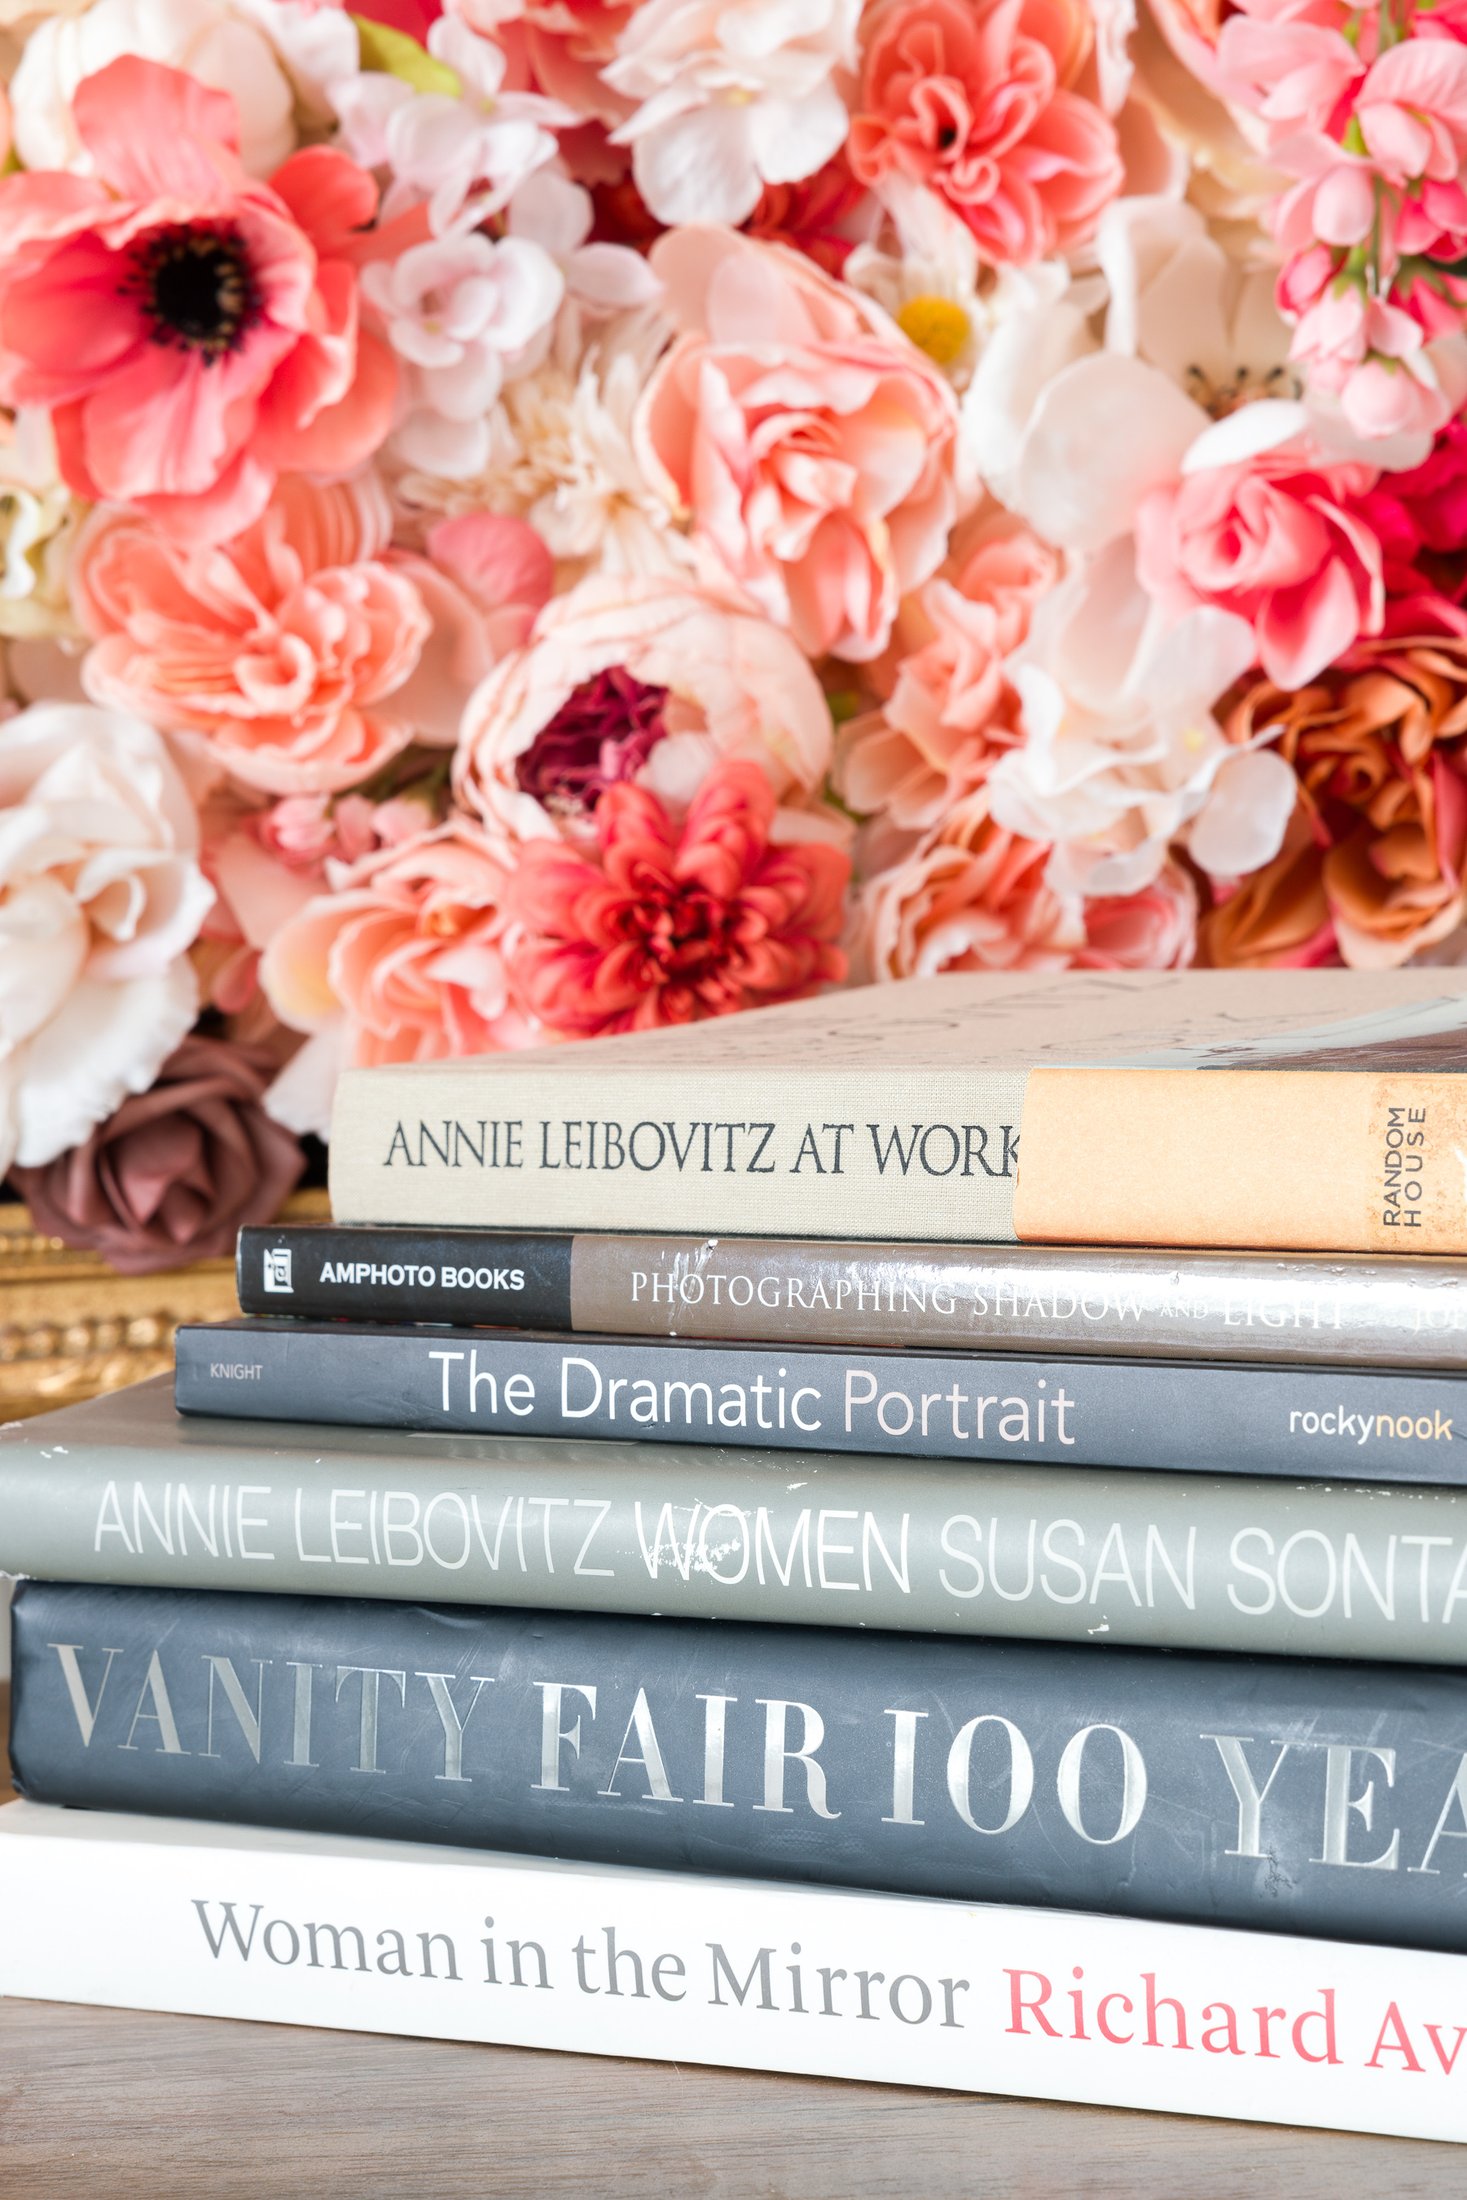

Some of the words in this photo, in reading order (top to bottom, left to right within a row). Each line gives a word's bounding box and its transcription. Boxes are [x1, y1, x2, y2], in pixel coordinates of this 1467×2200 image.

[383, 1120, 524, 1169] ANNIE
[539, 1120, 775, 1174] LEIBOVITZ
[790, 1123, 854, 1175] AT
[1383, 1107, 1406, 1227] RANDOM
[1404, 1107, 1426, 1227] HOUSE
[319, 1261, 436, 1288] AMPHOTO
[441, 1266, 525, 1291] BOOKS
[631, 1271, 957, 1314] PHOTOGRAPHING
[973, 1284, 1145, 1322] SHADOW
[1159, 1300, 1209, 1320] AND
[1223, 1295, 1347, 1330] LIGHT
[210, 1362, 264, 1380] KNIGHT
[428, 1349, 536, 1416] The
[561, 1357, 822, 1432] Dramatic
[844, 1369, 1076, 1446] Portrait
[1289, 1404, 1454, 1446] rockynook
[94, 1480, 275, 1561] ANNIE
[296, 1487, 616, 1578] LEIBOVITZ
[634, 1500, 912, 1594] WOMEN
[938, 1514, 1197, 1610] SUSAN
[47, 1642, 495, 1783] VANITY
[531, 1680, 842, 1820] FAIR
[190, 1899, 464, 1981] Woman
[479, 1915, 555, 1990] in
[571, 1925, 688, 2002] the
[705, 1941, 971, 2029] Mirror
[1002, 1966, 1345, 2065] Richard
[1363, 2001, 1467, 2076] Av
